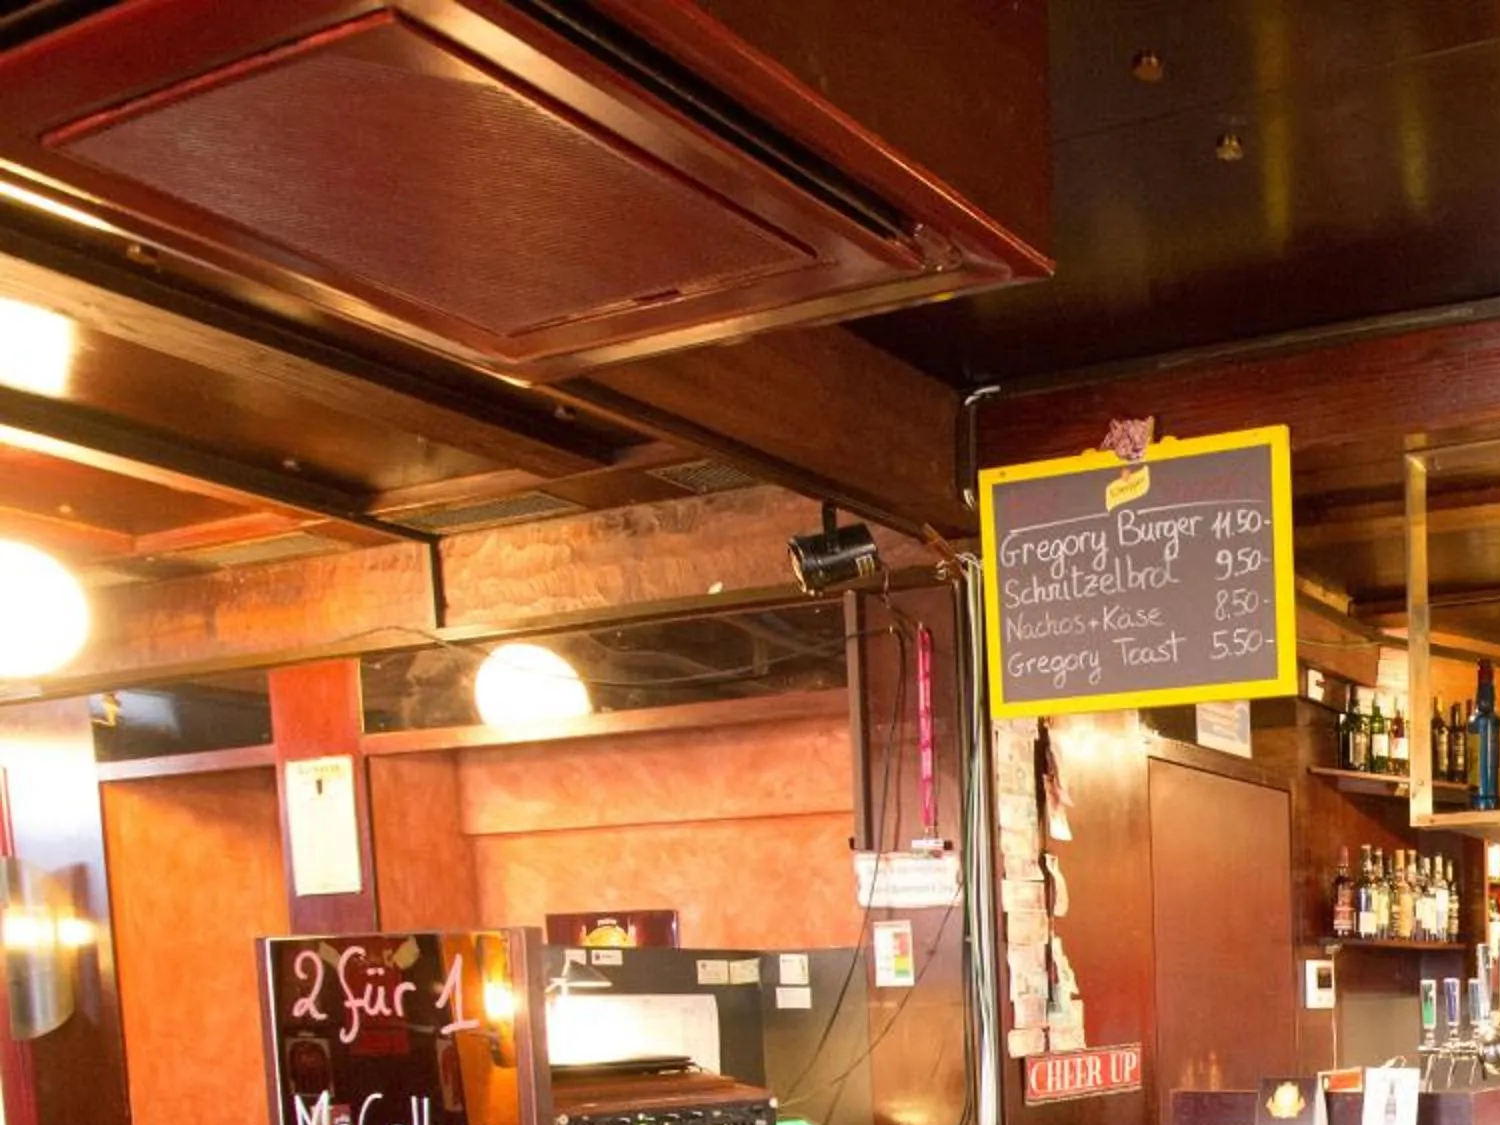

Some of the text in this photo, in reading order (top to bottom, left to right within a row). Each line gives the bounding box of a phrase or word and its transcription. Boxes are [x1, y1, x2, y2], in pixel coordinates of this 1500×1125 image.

[1000, 530, 1109, 580] Gregory
[1117, 509, 1204, 562] Burger
[1007, 648, 1103, 690] Gregory
[1112, 630, 1187, 666] Toast
[292, 945, 480, 1044] 2 für 1
[1031, 1050, 1138, 1094] CHEER UP
